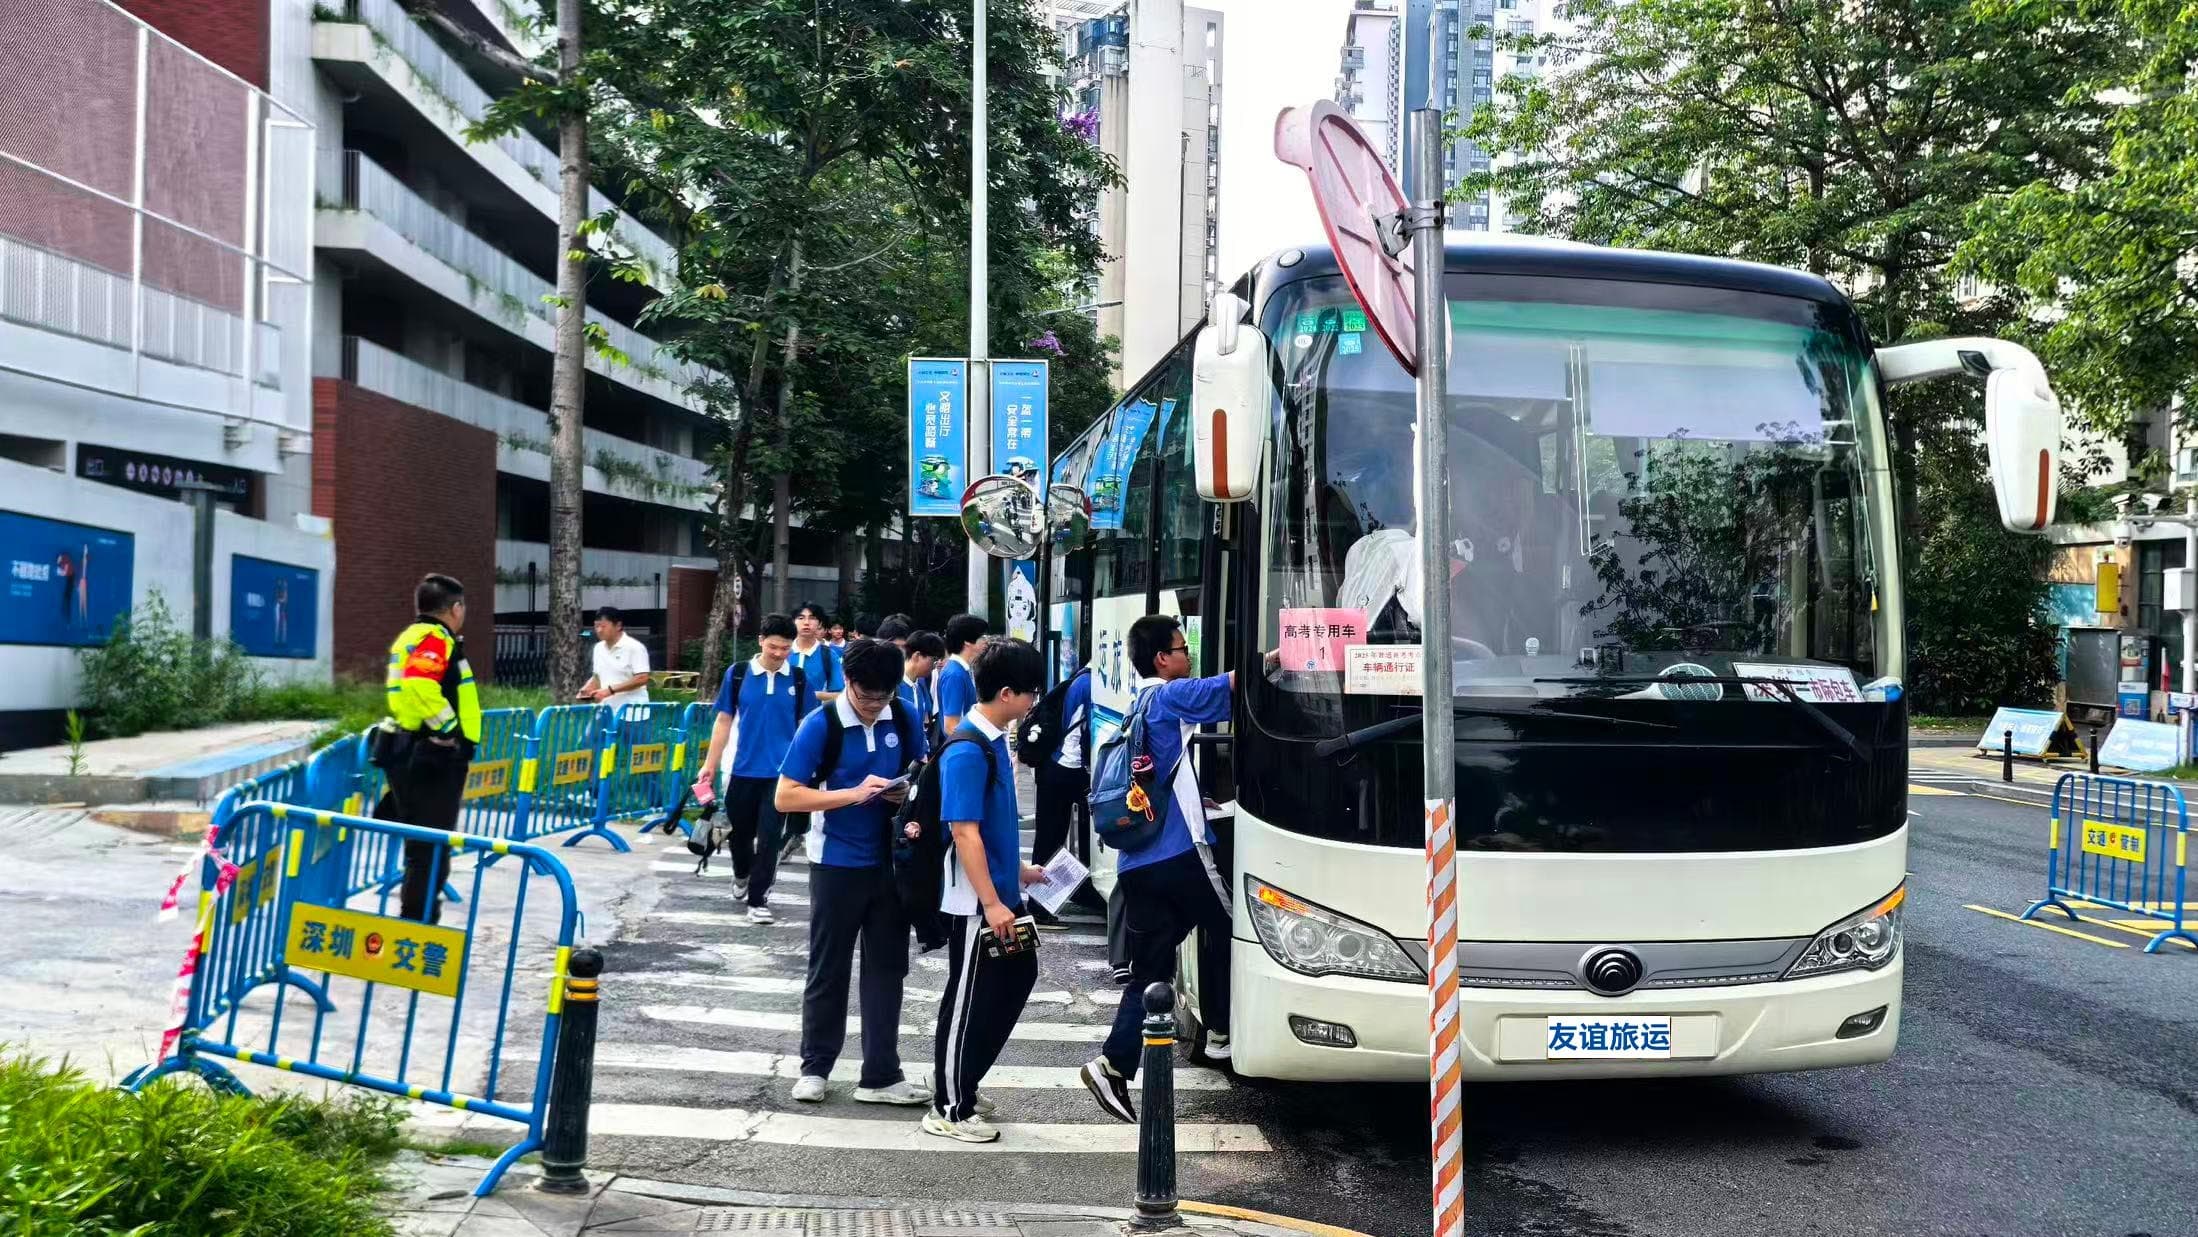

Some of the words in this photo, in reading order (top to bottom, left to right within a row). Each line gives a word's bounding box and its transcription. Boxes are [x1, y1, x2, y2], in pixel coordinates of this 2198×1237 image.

[1284, 624, 1356, 639] 高考专用车
[1319, 646, 1326, 660] 1
[1363, 661, 1415, 673] 车辆通行证
[2087, 828, 2106, 847] 交通
[300, 920, 355, 960] 深圳
[391, 937, 449, 978] 交警
[1548, 1022, 1671, 1051] 友谊旅运
